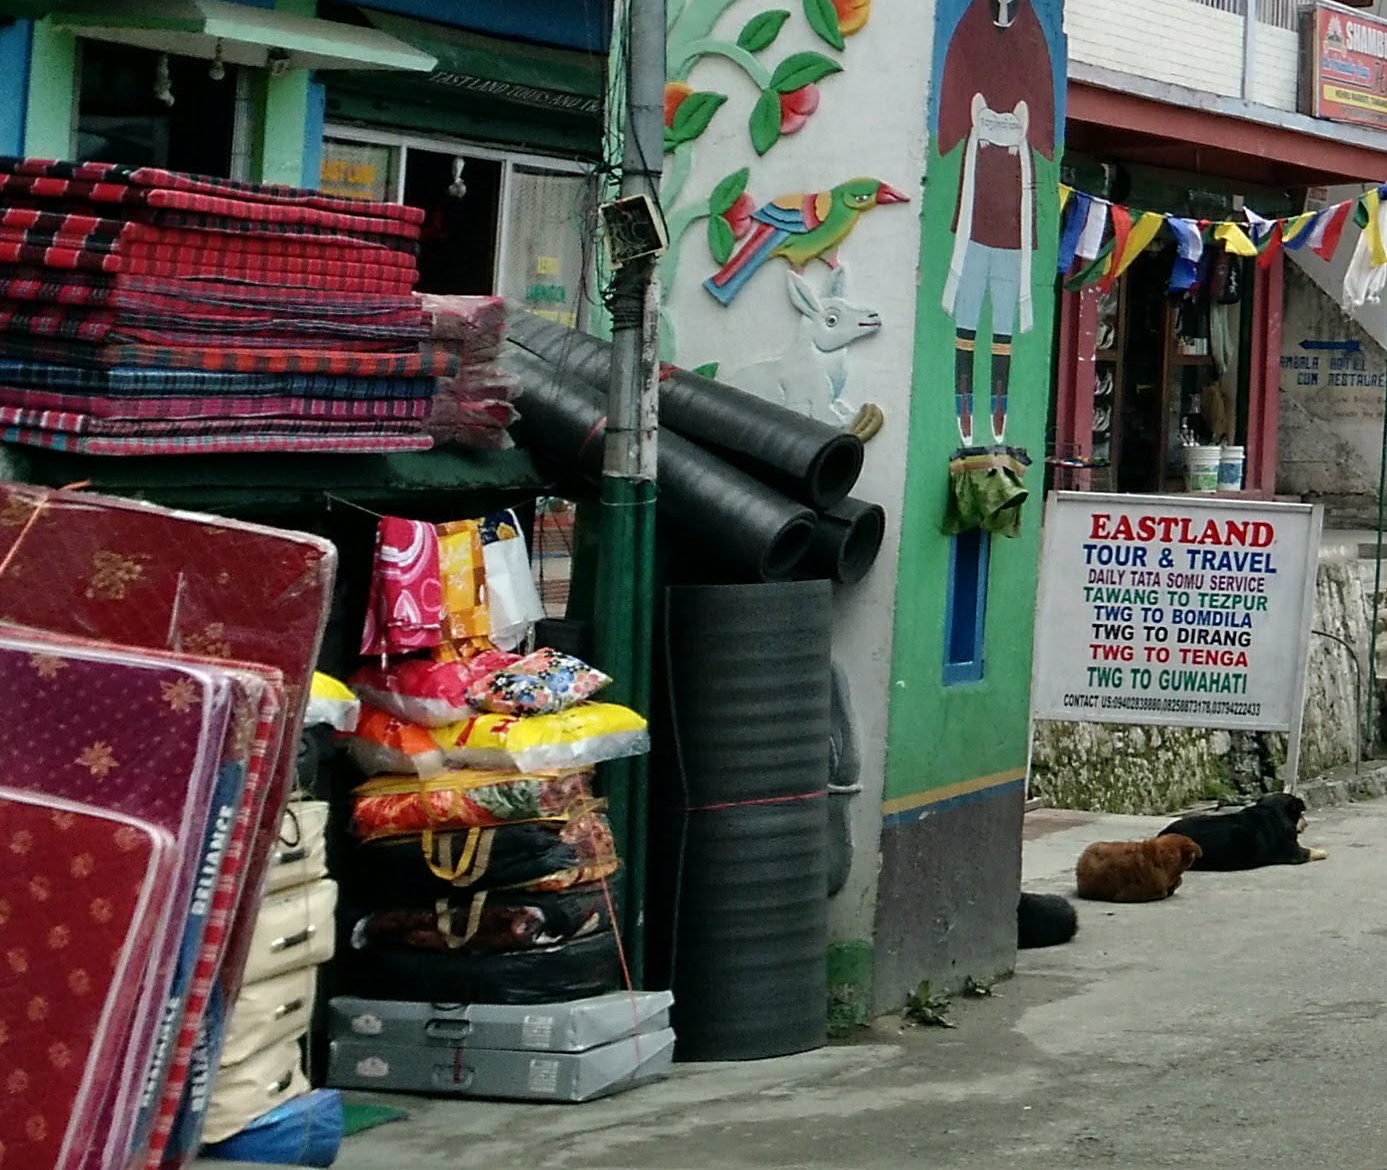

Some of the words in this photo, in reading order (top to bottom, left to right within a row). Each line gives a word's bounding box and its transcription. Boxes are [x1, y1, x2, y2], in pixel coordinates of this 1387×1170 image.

[1089, 513, 1275, 548] EASTLAND
[1083, 544, 1147, 567] TOUR
[1158, 547, 1174, 569] &
[1186, 549, 1277, 574] TRAVEL
[1088, 568, 1126, 586] DAILY
[1130, 570, 1161, 587] TATA
[1167, 572, 1204, 590] SOMU
[1209, 575, 1265, 593] SERVICE
[1083, 586, 1159, 606] TAWANG
[1164, 590, 1190, 607] TO
[1198, 592, 1268, 611] TEZPUR
[1094, 605, 1132, 622] TWG
[1141, 607, 1164, 624] TO
[1172, 609, 1252, 628] BOMDILA
[1092, 623, 1134, 642] TWG
[1143, 626, 1168, 643] TO
[1177, 628, 1251, 647] DIRANG
[1089, 644, 1134, 662] TWG
[1143, 646, 1170, 663] TO
[1179, 648, 1248, 667] TENGA
[1087, 666, 1122, 688] TWG
[1130, 668, 1152, 690] TO
[1158, 670, 1247, 694] GUWAHATI
[1063, 693, 1099, 709] CONTACT
